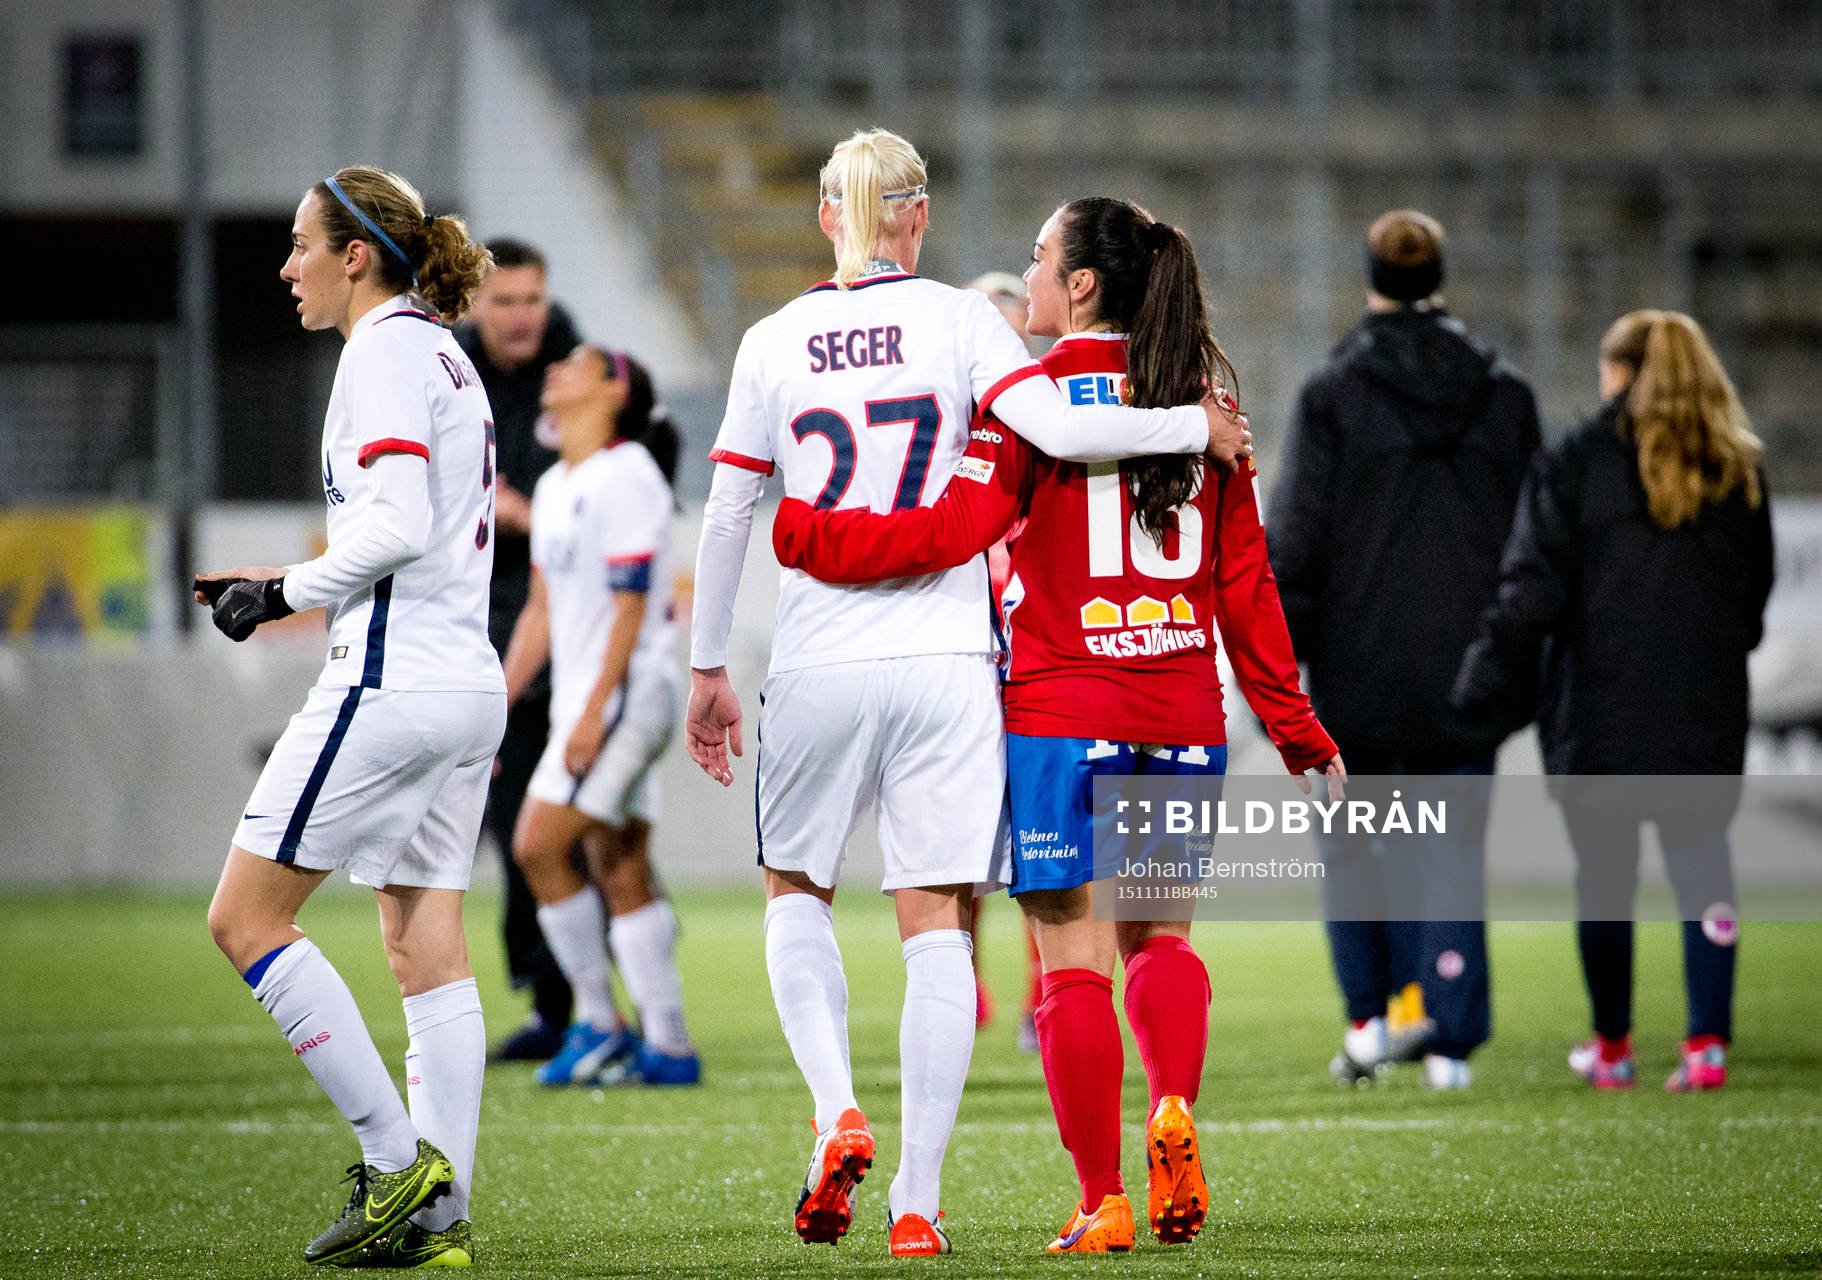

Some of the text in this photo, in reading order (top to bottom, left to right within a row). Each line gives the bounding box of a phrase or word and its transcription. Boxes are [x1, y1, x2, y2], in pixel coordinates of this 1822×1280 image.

[807, 325, 904, 373] SEGER
[790, 393, 943, 514] 27
[1084, 622, 1206, 658] EKSJÖHUS
